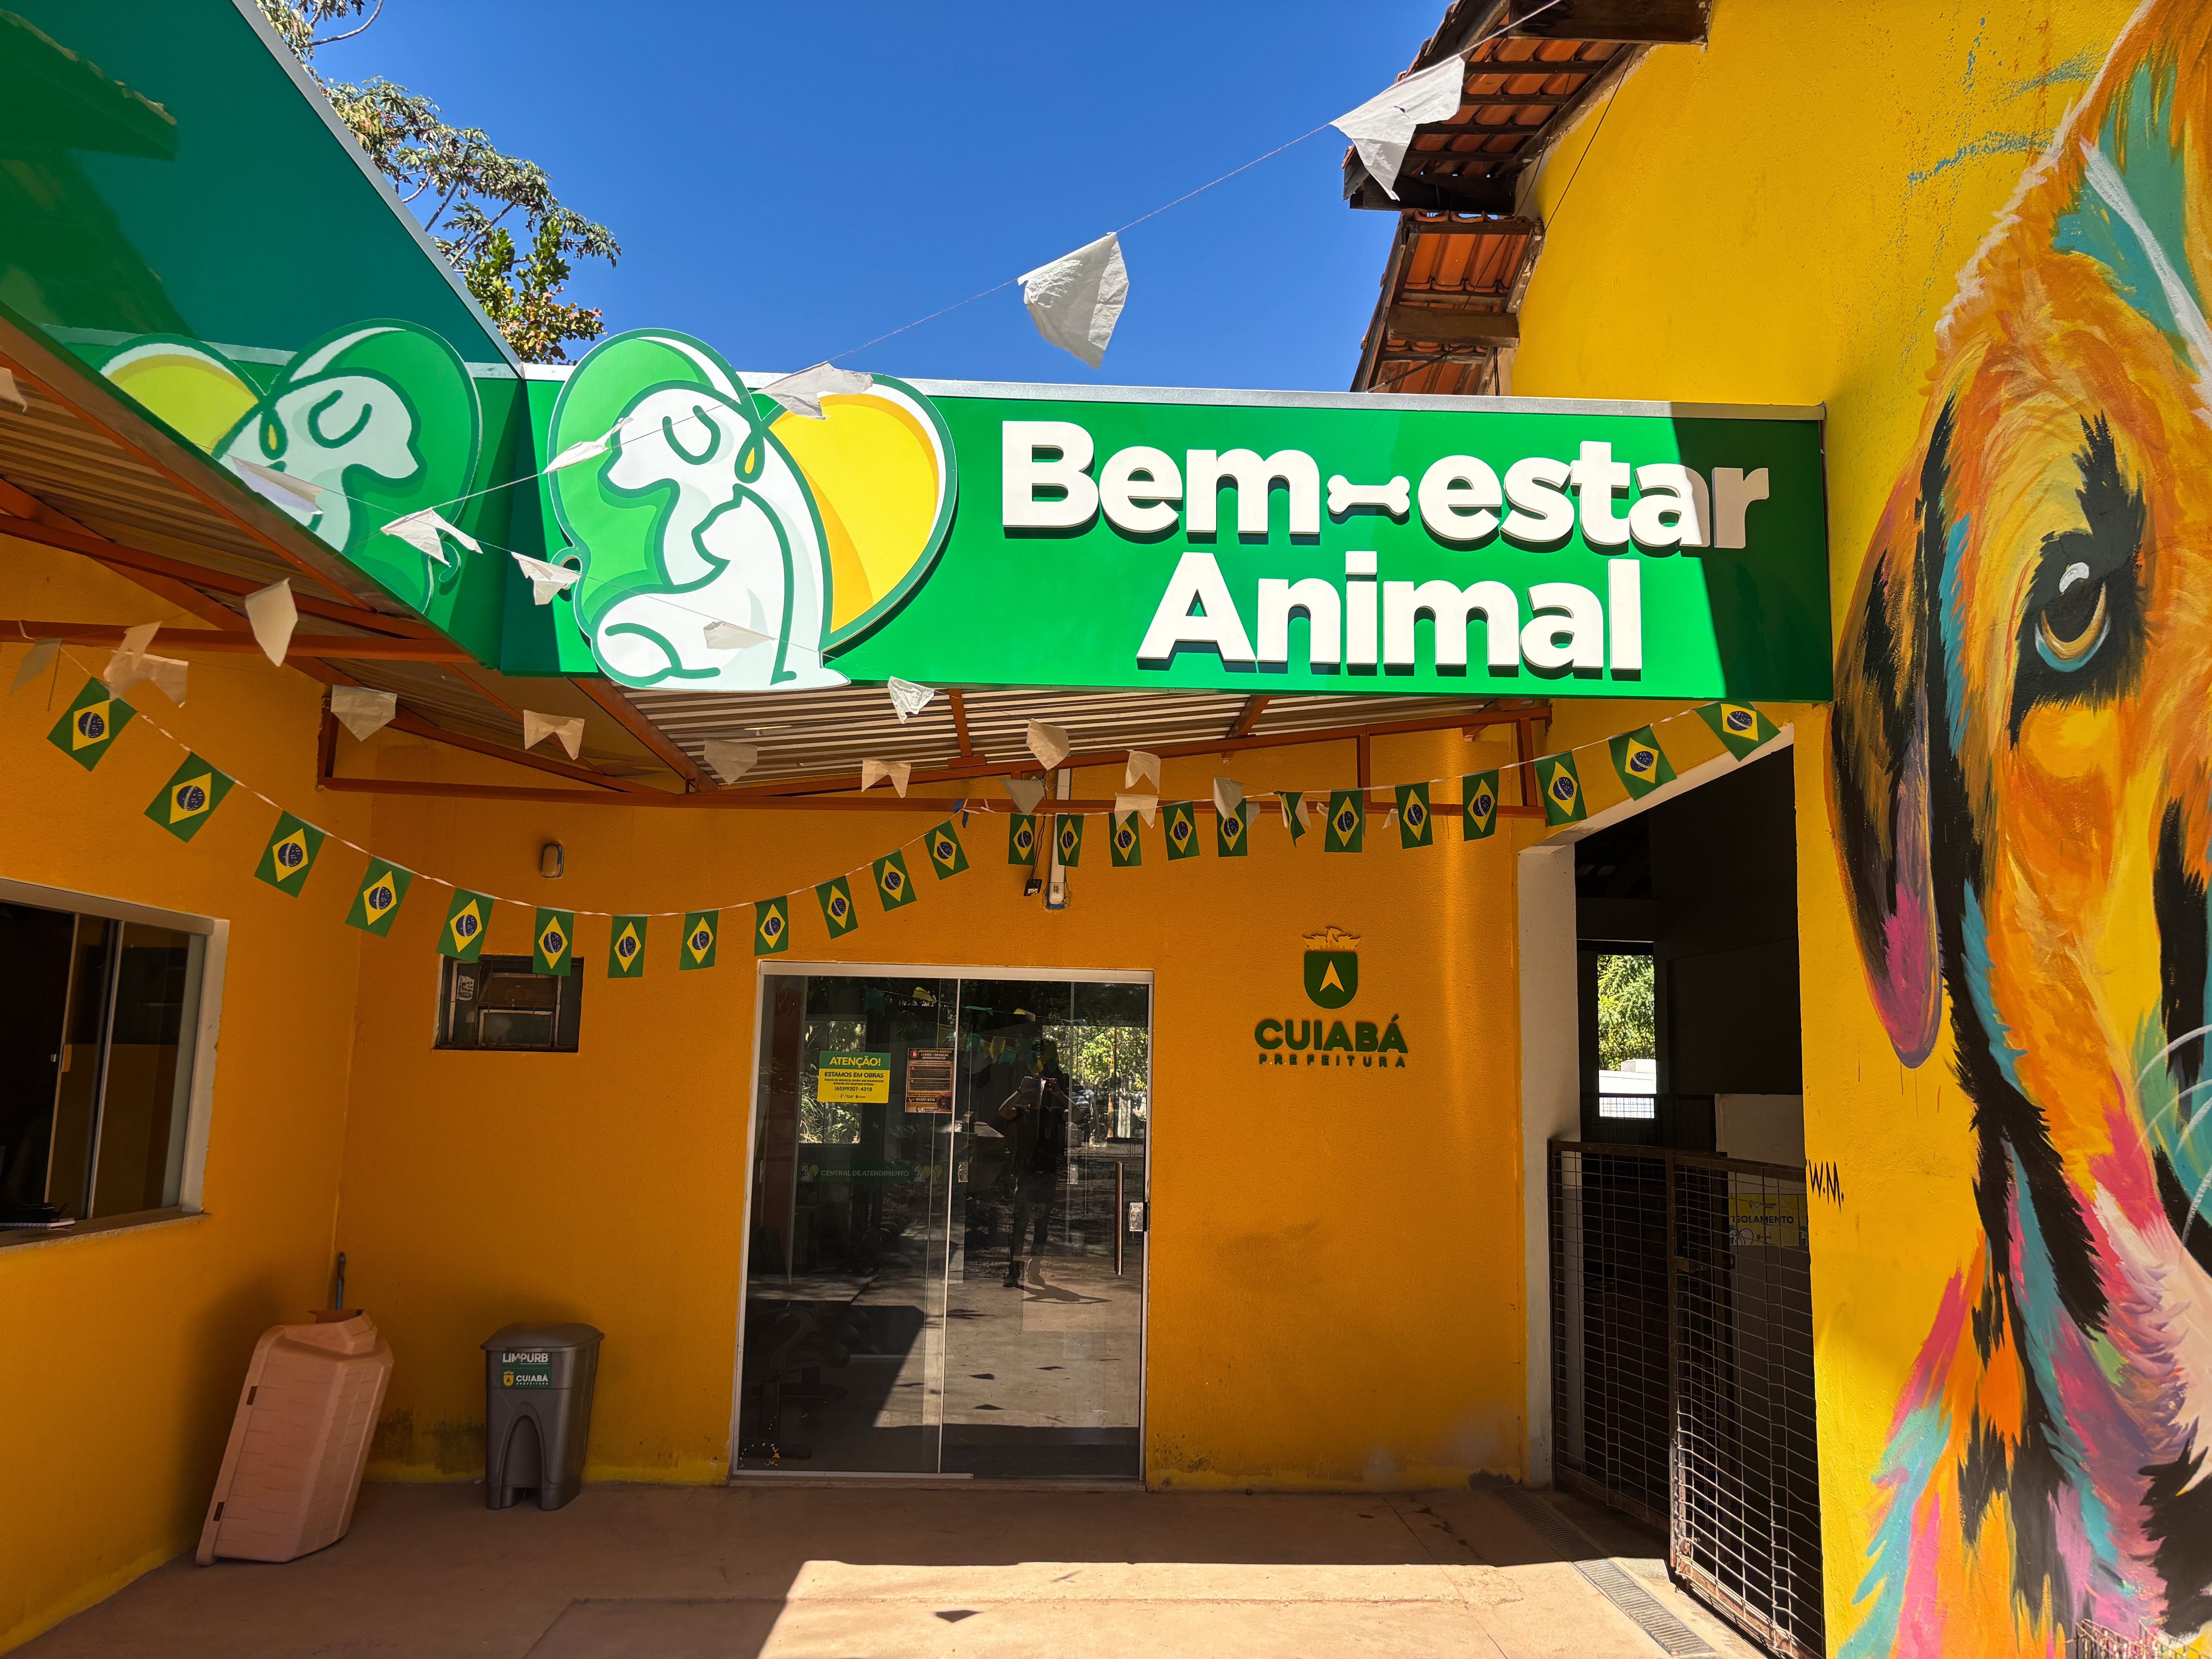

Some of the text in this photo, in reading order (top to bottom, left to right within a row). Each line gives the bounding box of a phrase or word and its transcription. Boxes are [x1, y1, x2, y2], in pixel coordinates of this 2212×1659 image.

[1136, 551, 1643, 671] Animal
[1254, 1014, 1408, 1053] CUIABÁ
[830, 1056, 881, 1068] ATENÇÃO!
[1259, 1054, 1405, 1068] PREFEITURA
[1808, 1159, 1844, 1211] W.M.
[1733, 1215, 1794, 1224] ISOLAMENTO
[502, 1353, 549, 1363] LIMPURB
[516, 1374, 548, 1382] CUIABÁ
